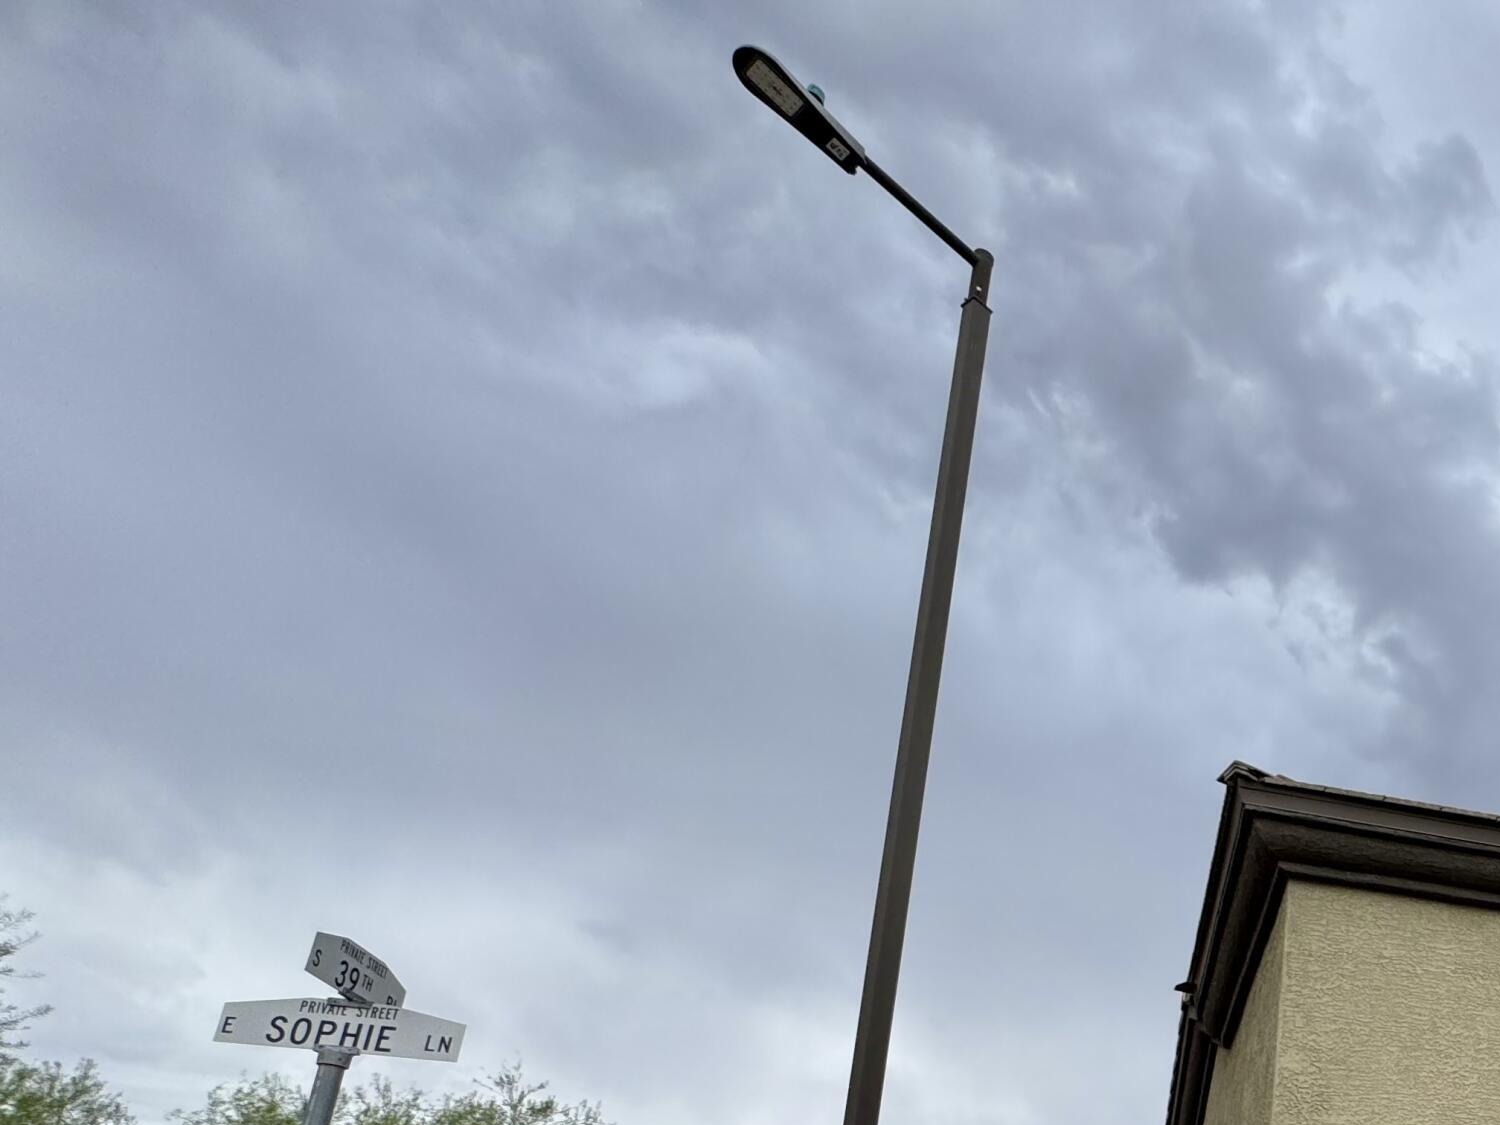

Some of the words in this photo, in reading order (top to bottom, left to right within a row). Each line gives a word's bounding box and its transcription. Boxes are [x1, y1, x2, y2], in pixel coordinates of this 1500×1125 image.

[312, 949, 322, 967] S
[340, 940, 366, 965] PRIVATE
[366, 956, 388, 979] STREET
[299, 1000, 347, 1016] PRIVATE
[356, 1005, 399, 1021] STREET
[221, 1016, 237, 1034] E
[265, 1015, 397, 1053] SOPHIE
[424, 1034, 453, 1053] LN
